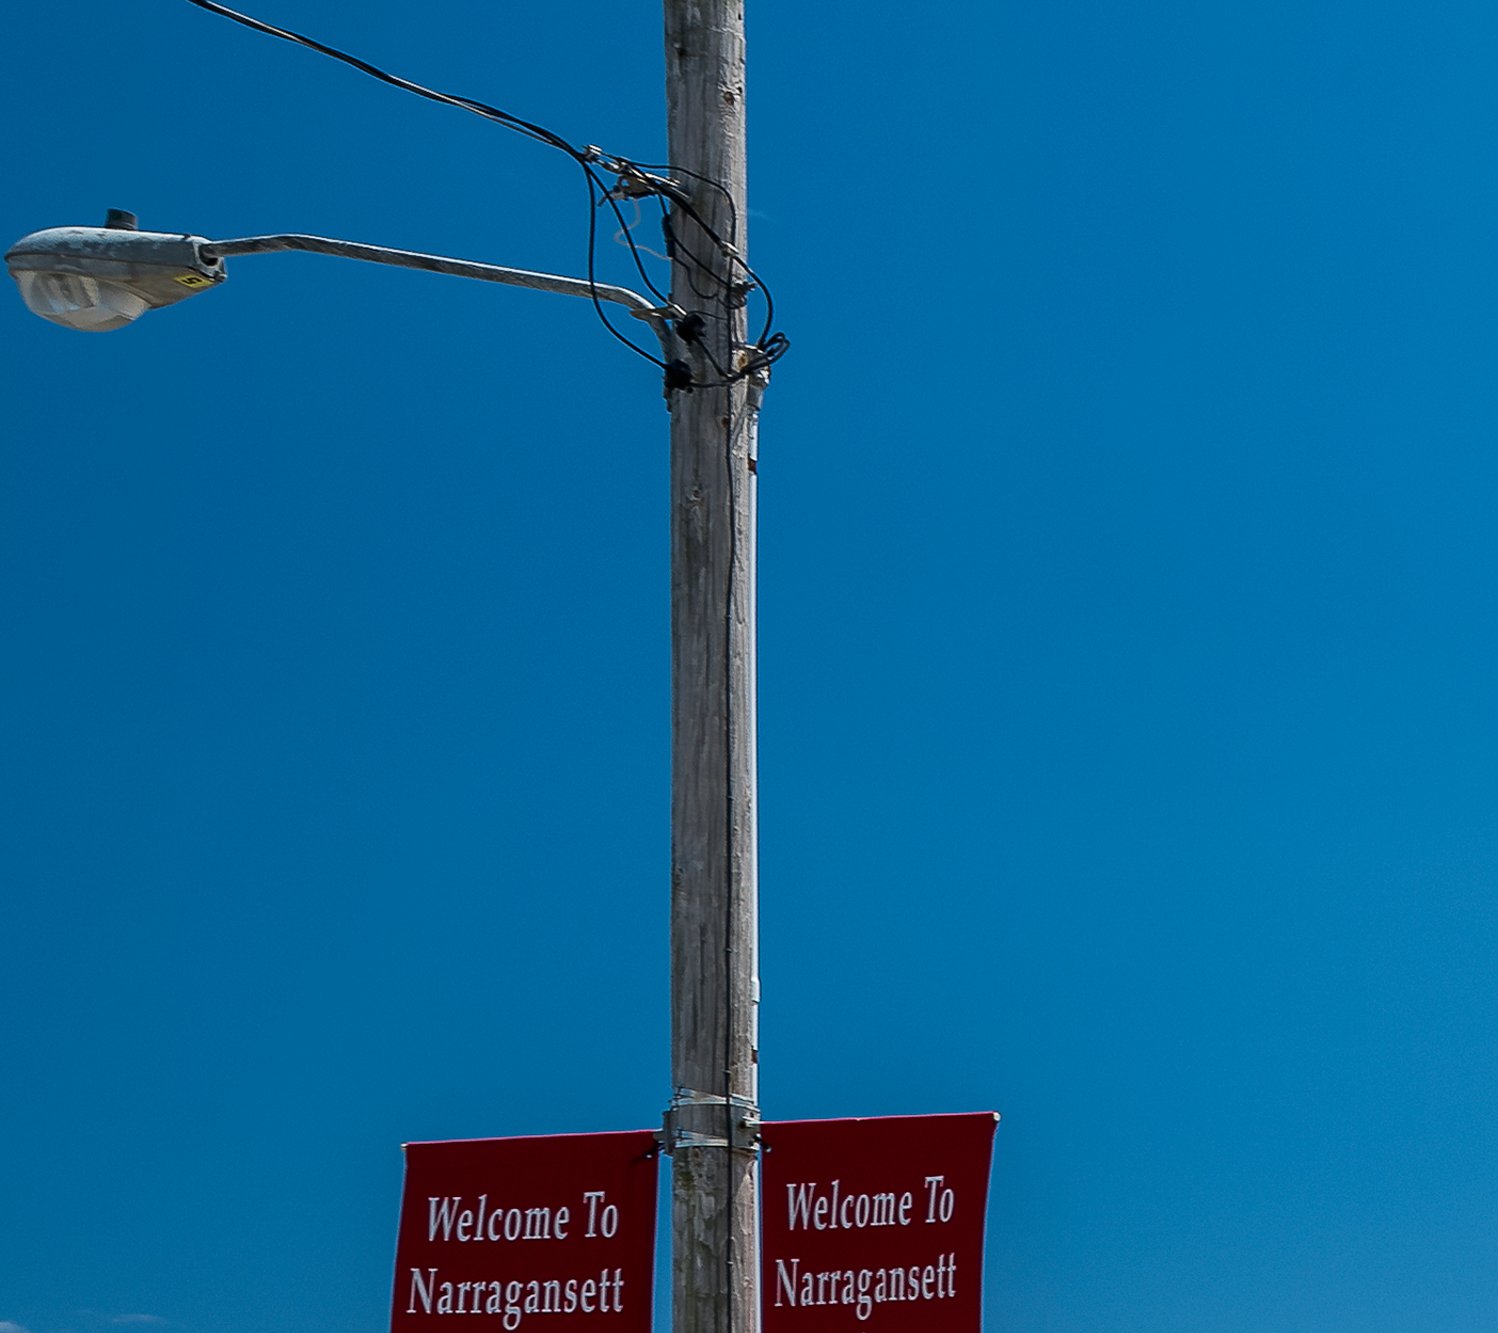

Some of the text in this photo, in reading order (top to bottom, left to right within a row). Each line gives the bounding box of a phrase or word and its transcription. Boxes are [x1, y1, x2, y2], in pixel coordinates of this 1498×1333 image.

[427, 1191, 619, 1242] Welcome To
[785, 1175, 955, 1231] Welcome To
[406, 1267, 625, 1332] Narragansett
[774, 1252, 957, 1321] Narragansett
